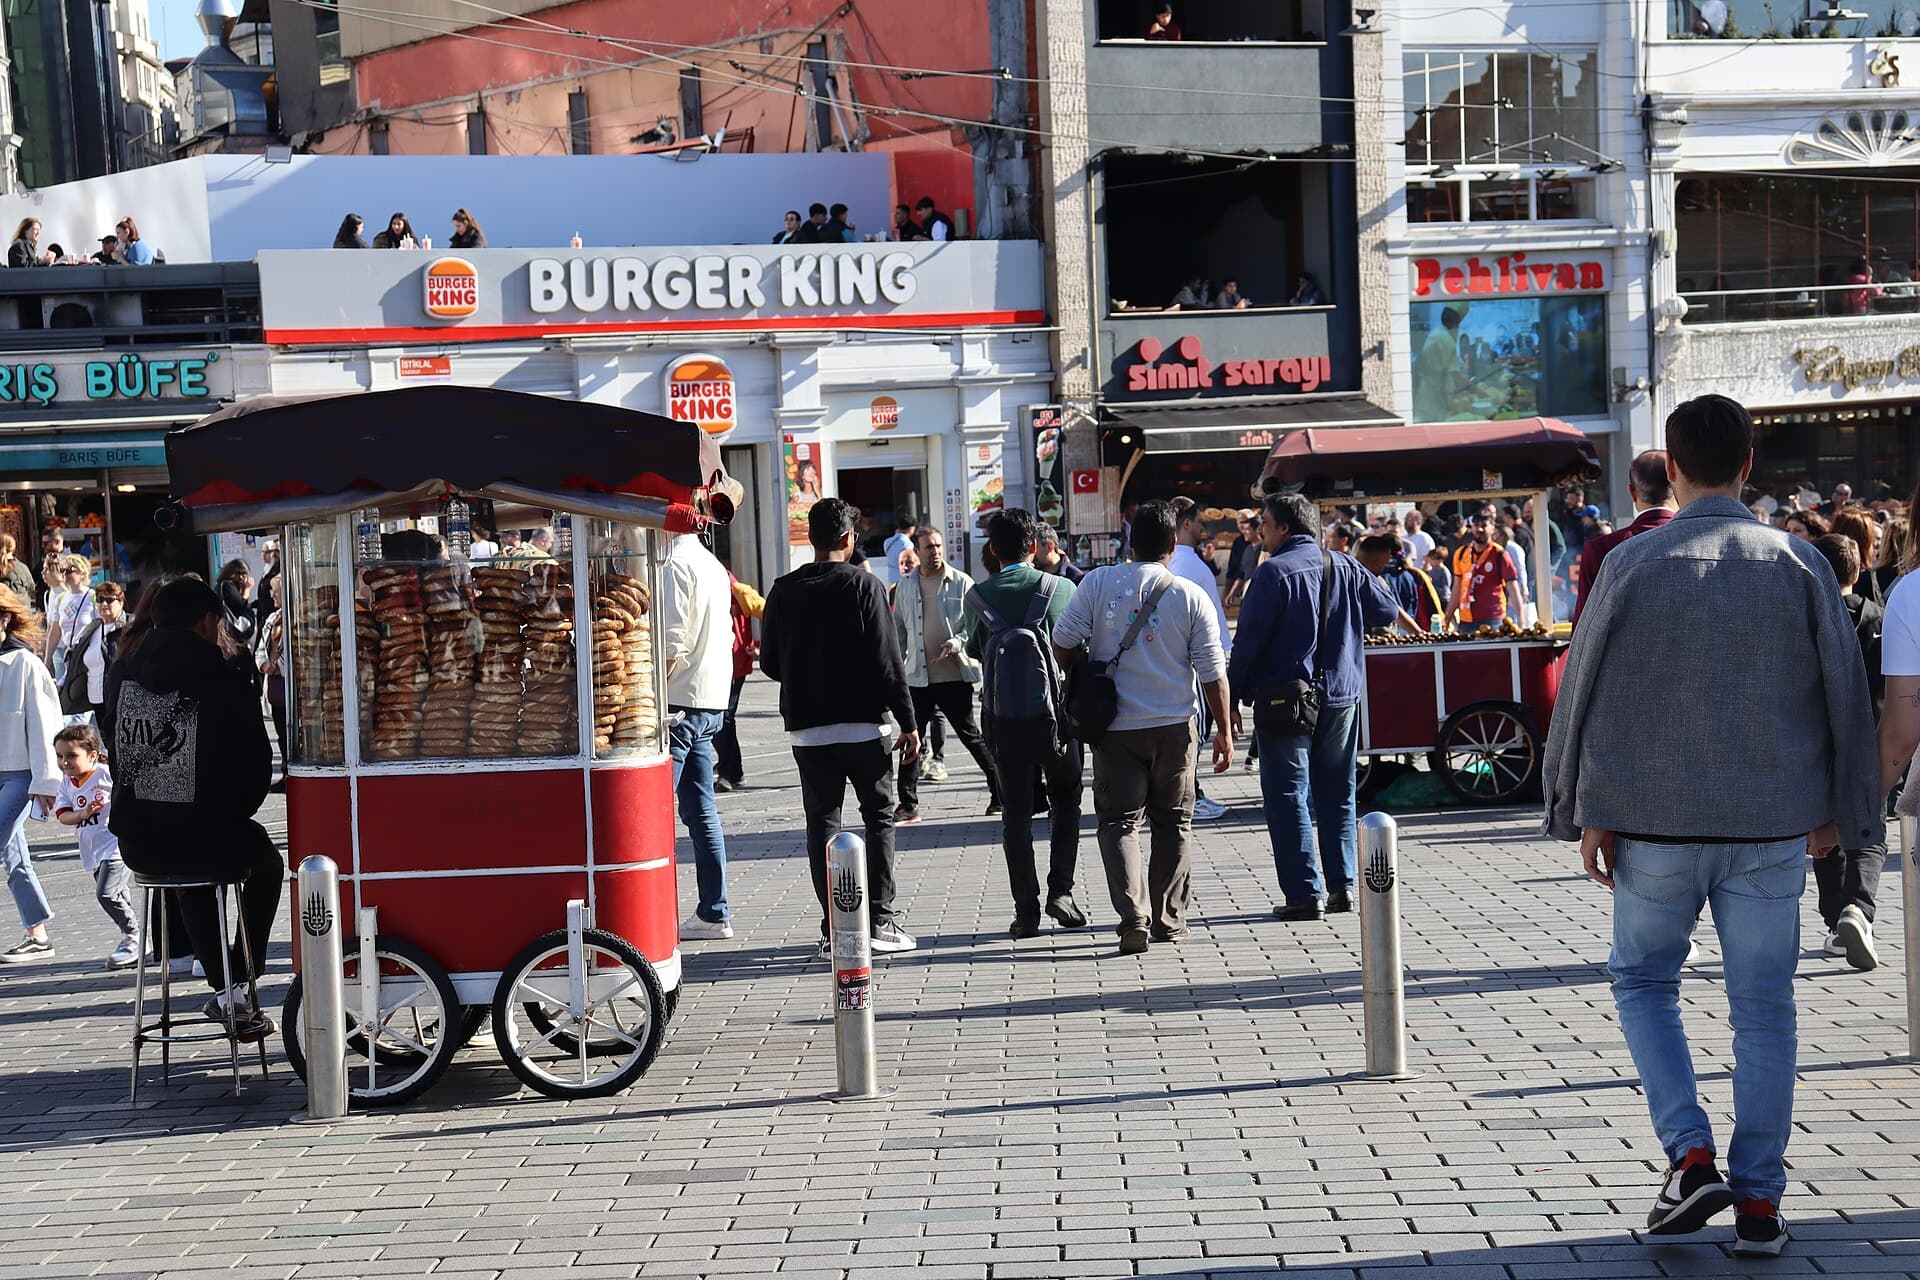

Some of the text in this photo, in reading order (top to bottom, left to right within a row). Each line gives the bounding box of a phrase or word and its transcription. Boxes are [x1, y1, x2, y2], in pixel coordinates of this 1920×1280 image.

[529, 251, 918, 313] BURGER KING
[1414, 252, 1604, 296] Pehlivan
[428, 278, 476, 289] BURGER
[429, 289, 477, 306] KING
[1128, 335, 1331, 392] simit sarayı
[86, 354, 209, 398] BÜFE
[671, 382, 731, 398] BURGER
[671, 398, 732, 420] KING
[872, 413, 899, 424] KING
[1240, 430, 1274, 446] simit
[59, 449, 141, 464] BARIŞ BÜFE
